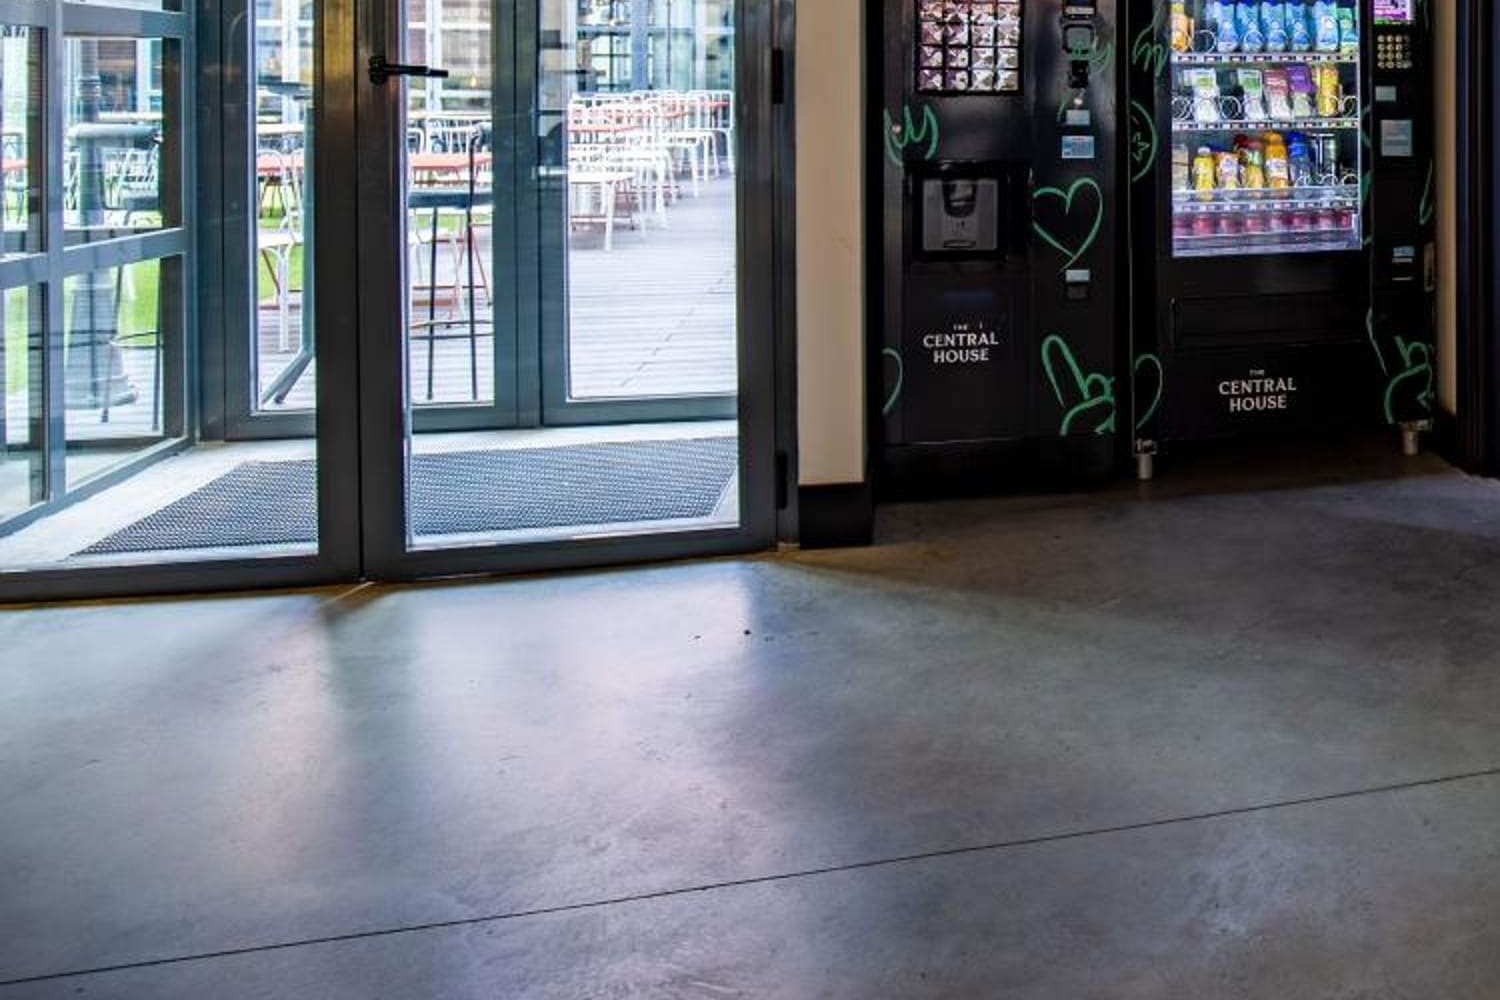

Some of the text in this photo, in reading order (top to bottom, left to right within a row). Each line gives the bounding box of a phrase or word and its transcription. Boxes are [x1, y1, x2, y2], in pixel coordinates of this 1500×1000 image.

[923, 331, 999, 348] CENTRAL
[933, 347, 989, 363] HOUSE
[1218, 377, 1297, 395] CENTRAL
[1229, 394, 1287, 412] HOUSE
